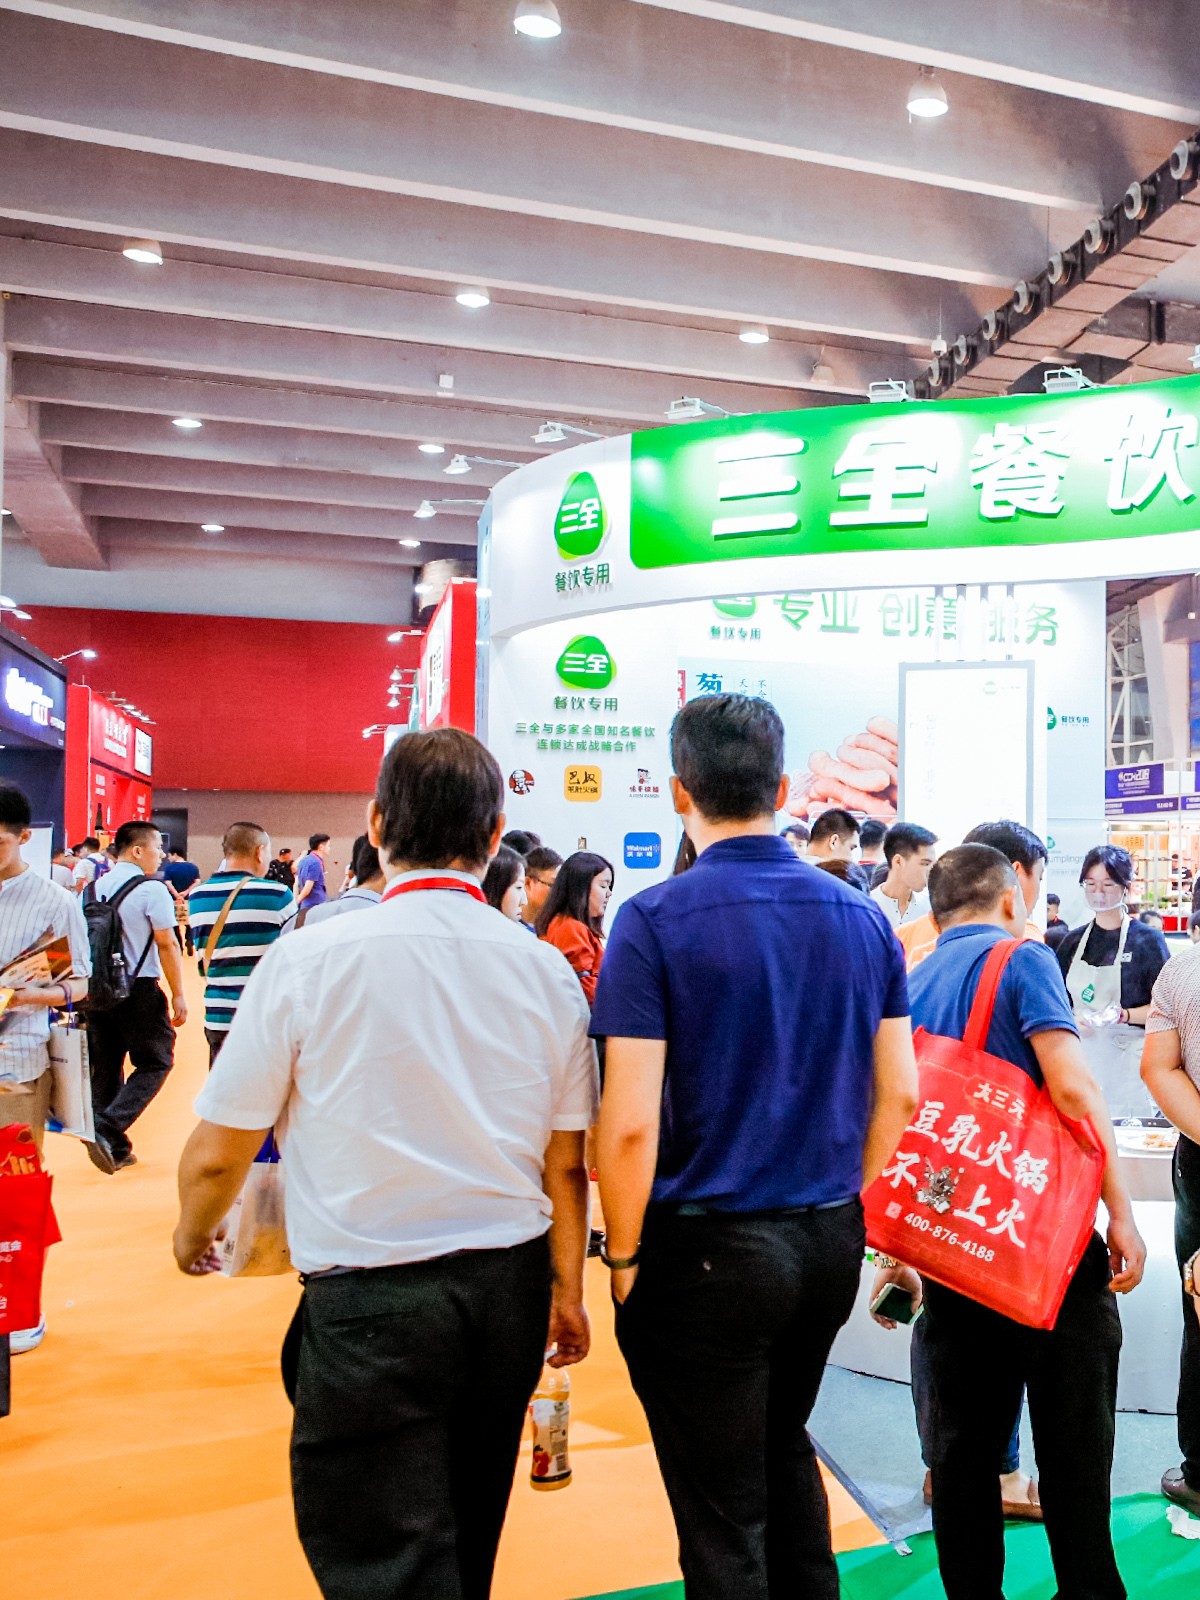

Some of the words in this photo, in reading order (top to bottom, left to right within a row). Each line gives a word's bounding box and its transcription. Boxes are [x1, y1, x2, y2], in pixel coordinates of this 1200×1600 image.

[710, 406, 1200, 542] 三全餐饮
[559, 497, 601, 534] 三全
[554, 562, 611, 593] 餐饮专用
[773, 592, 860, 635] 专业
[709, 625, 762, 641] 餐饮专用
[562, 652, 610, 675] 三全
[553, 696, 619, 713] 餐饮专用
[515, 722, 656, 738] 三全与多家全国知名餐饮
[536, 738, 638, 753] 连锁达成战略合作
[904, 1100, 1050, 1195] 豆乳火锅
[952, 1184, 1027, 1249] 上火
[903, 1211, 996, 1263] 400-876-4188
